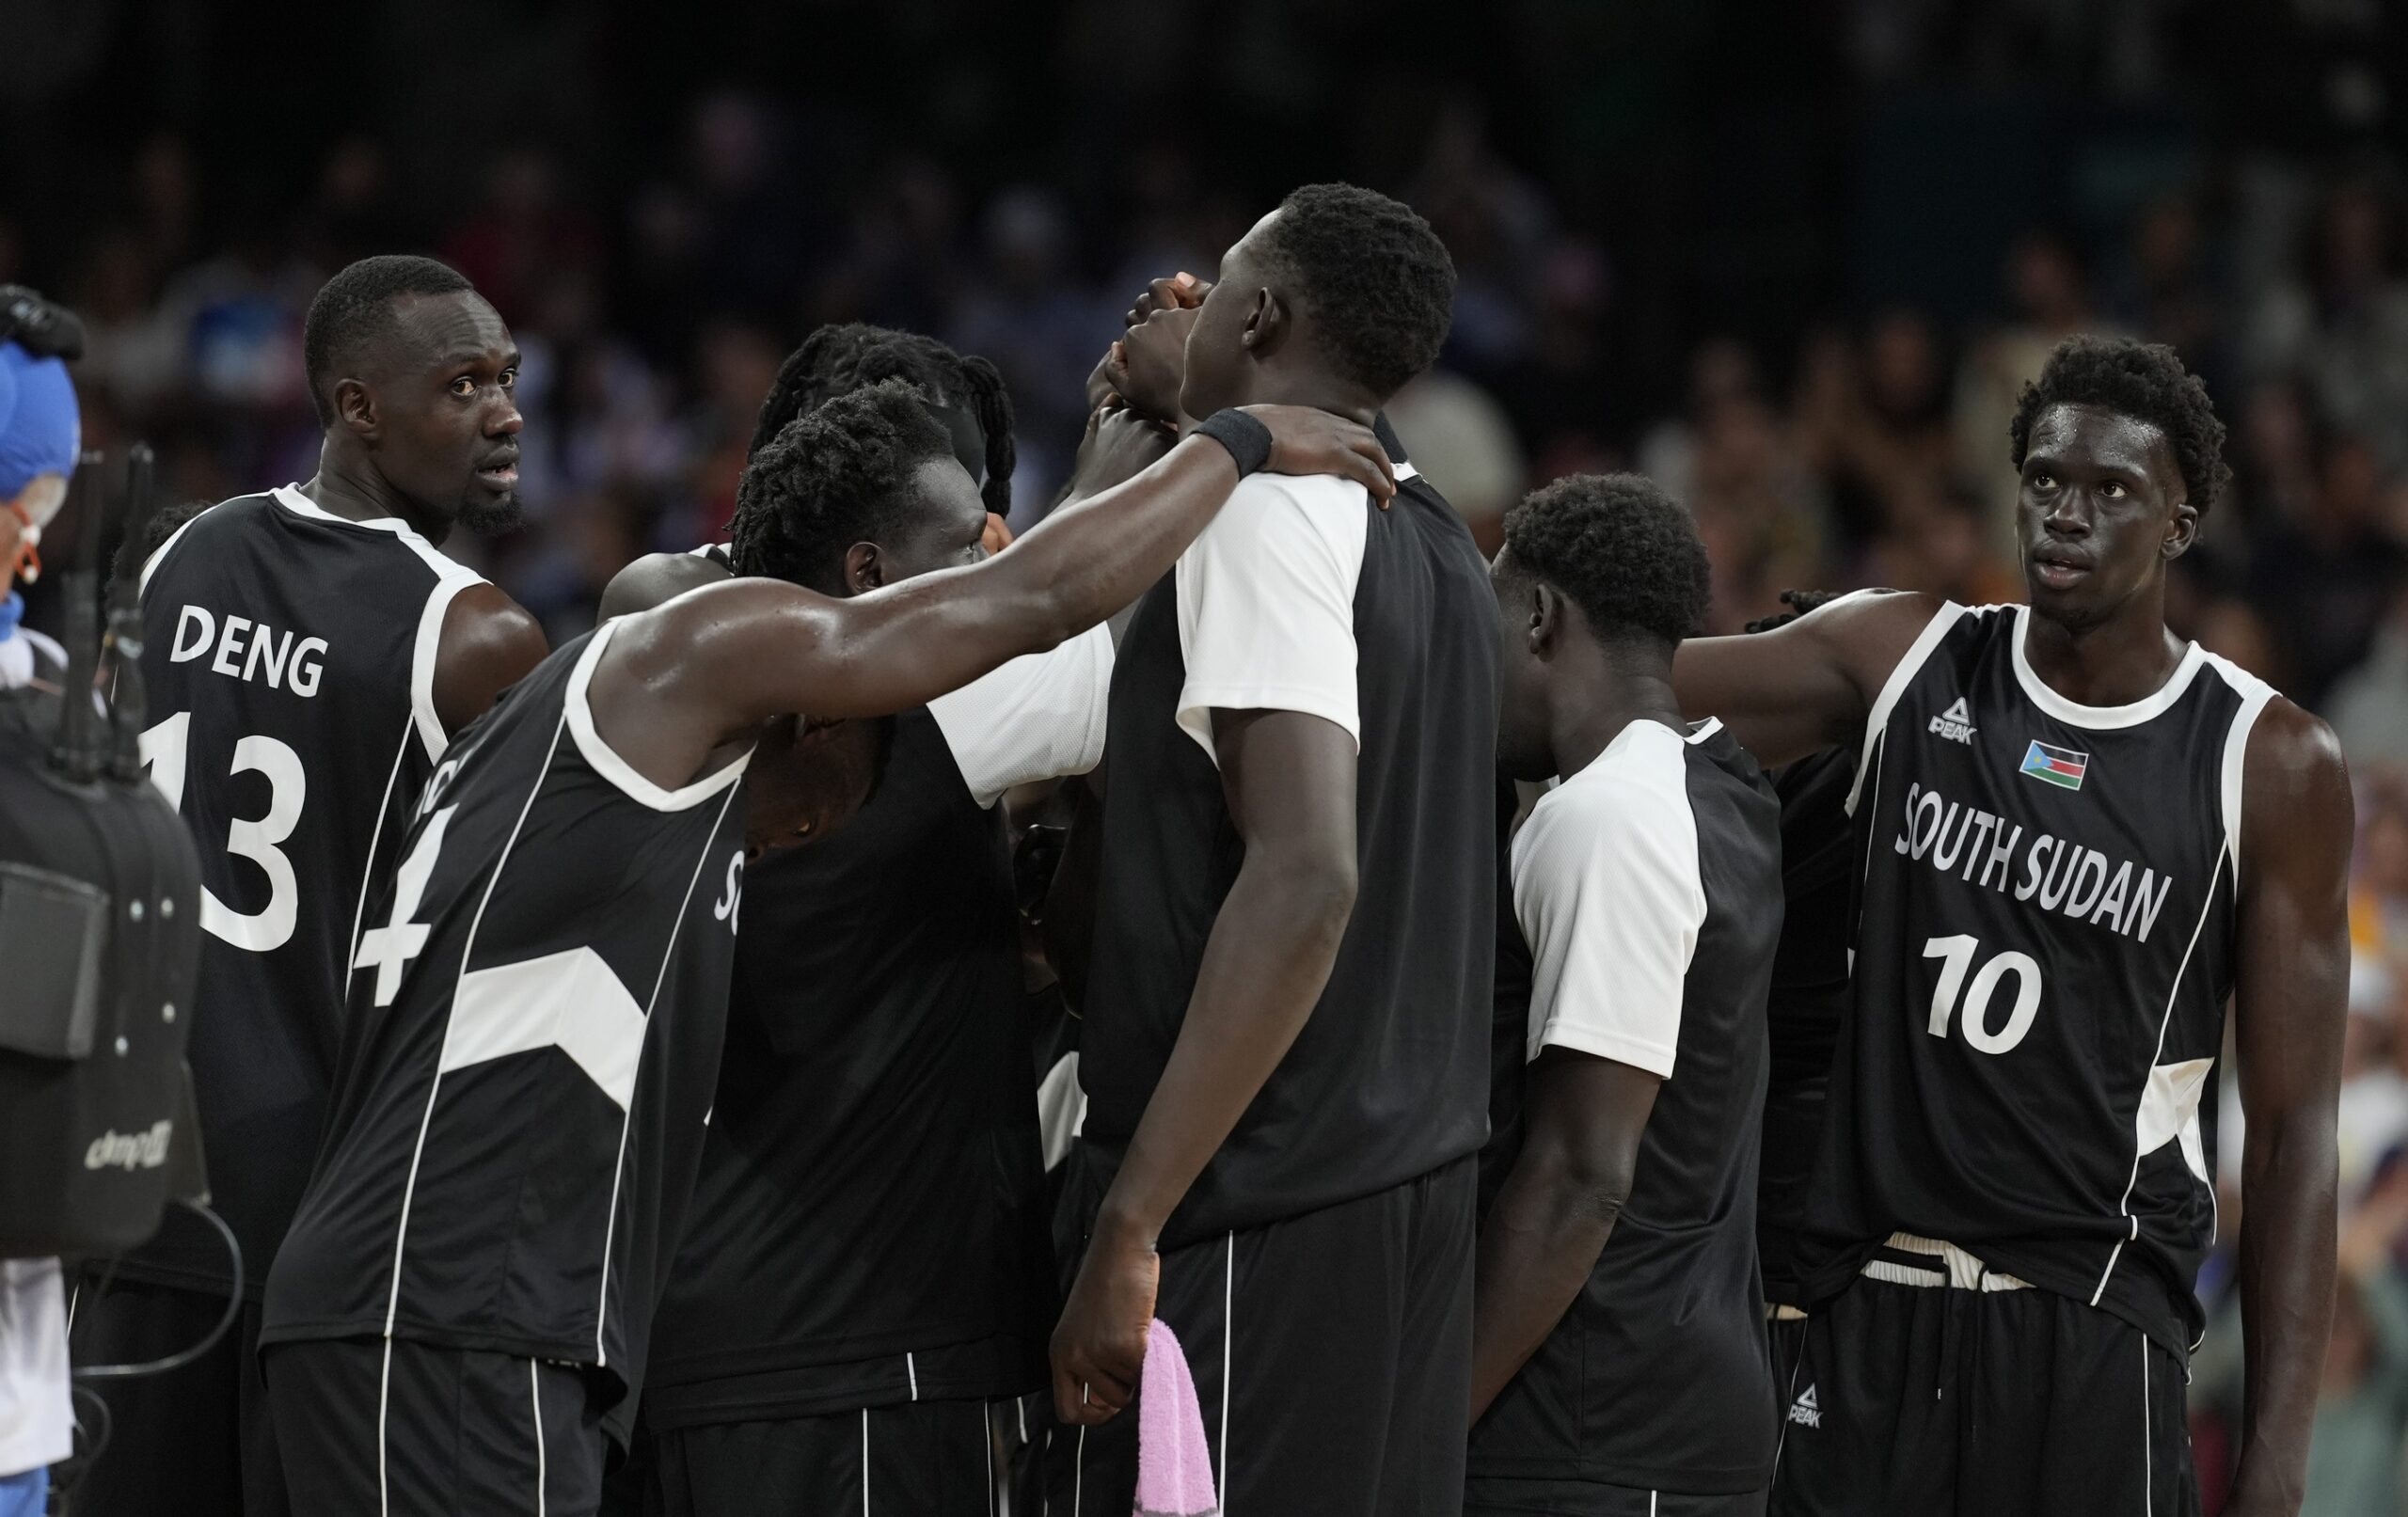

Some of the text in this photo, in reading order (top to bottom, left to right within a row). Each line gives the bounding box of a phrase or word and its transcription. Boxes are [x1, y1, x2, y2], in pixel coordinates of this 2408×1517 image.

[170, 605, 329, 698] DENG
[1927, 716, 1977, 746] PEAK
[137, 711, 307, 952] 13
[1894, 782, 2173, 943] SOUTH SUDAN
[1922, 933, 2042, 1054] 10
[1788, 1403, 1824, 1429] PEAK
